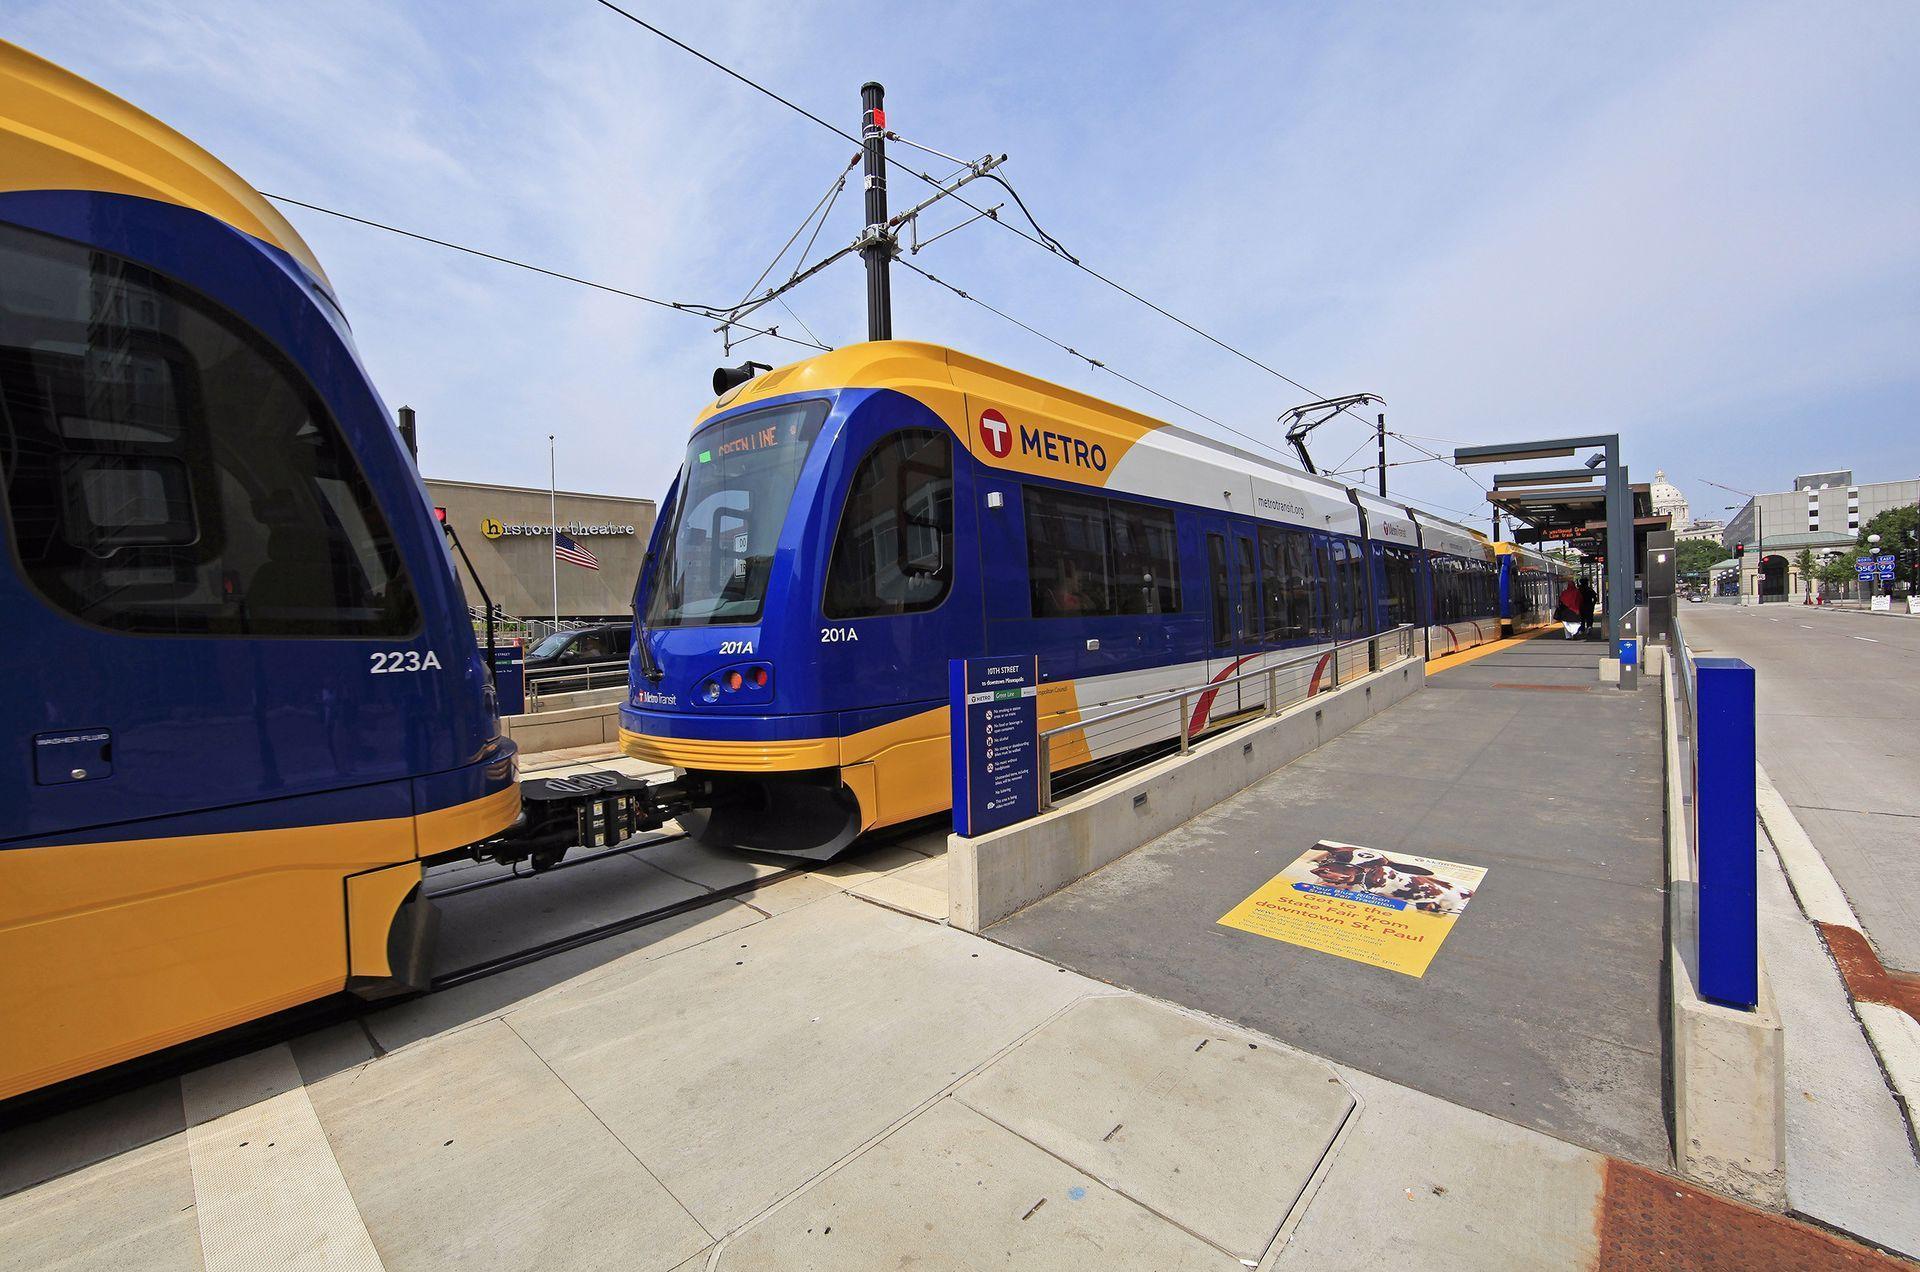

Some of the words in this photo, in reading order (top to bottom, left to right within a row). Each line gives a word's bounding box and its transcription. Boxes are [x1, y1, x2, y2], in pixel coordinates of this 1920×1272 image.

[1020, 424, 1107, 471] METRO
[1258, 497, 1305, 519] metrotransit.org
[486, 519, 563, 536] history
[569, 521, 635, 536] theatre
[820, 627, 859, 643] 201A
[719, 641, 754, 655] 201A
[370, 650, 442, 674] 223A
[1001, 666, 1019, 674] STREET
[1303, 893, 1334, 904] Get
[1340, 901, 1356, 909] to
[1364, 906, 1392, 917] the
[1356, 896, 1395, 908] Tradition
[1357, 893, 1390, 902] Ribbon
[1255, 900, 1344, 925] downtown
[1351, 921, 1374, 932] St.
[1382, 928, 1424, 943] Paul
[1278, 896, 1320, 910] State
[1327, 907, 1359, 918] Fair
[1366, 915, 1408, 930] from
